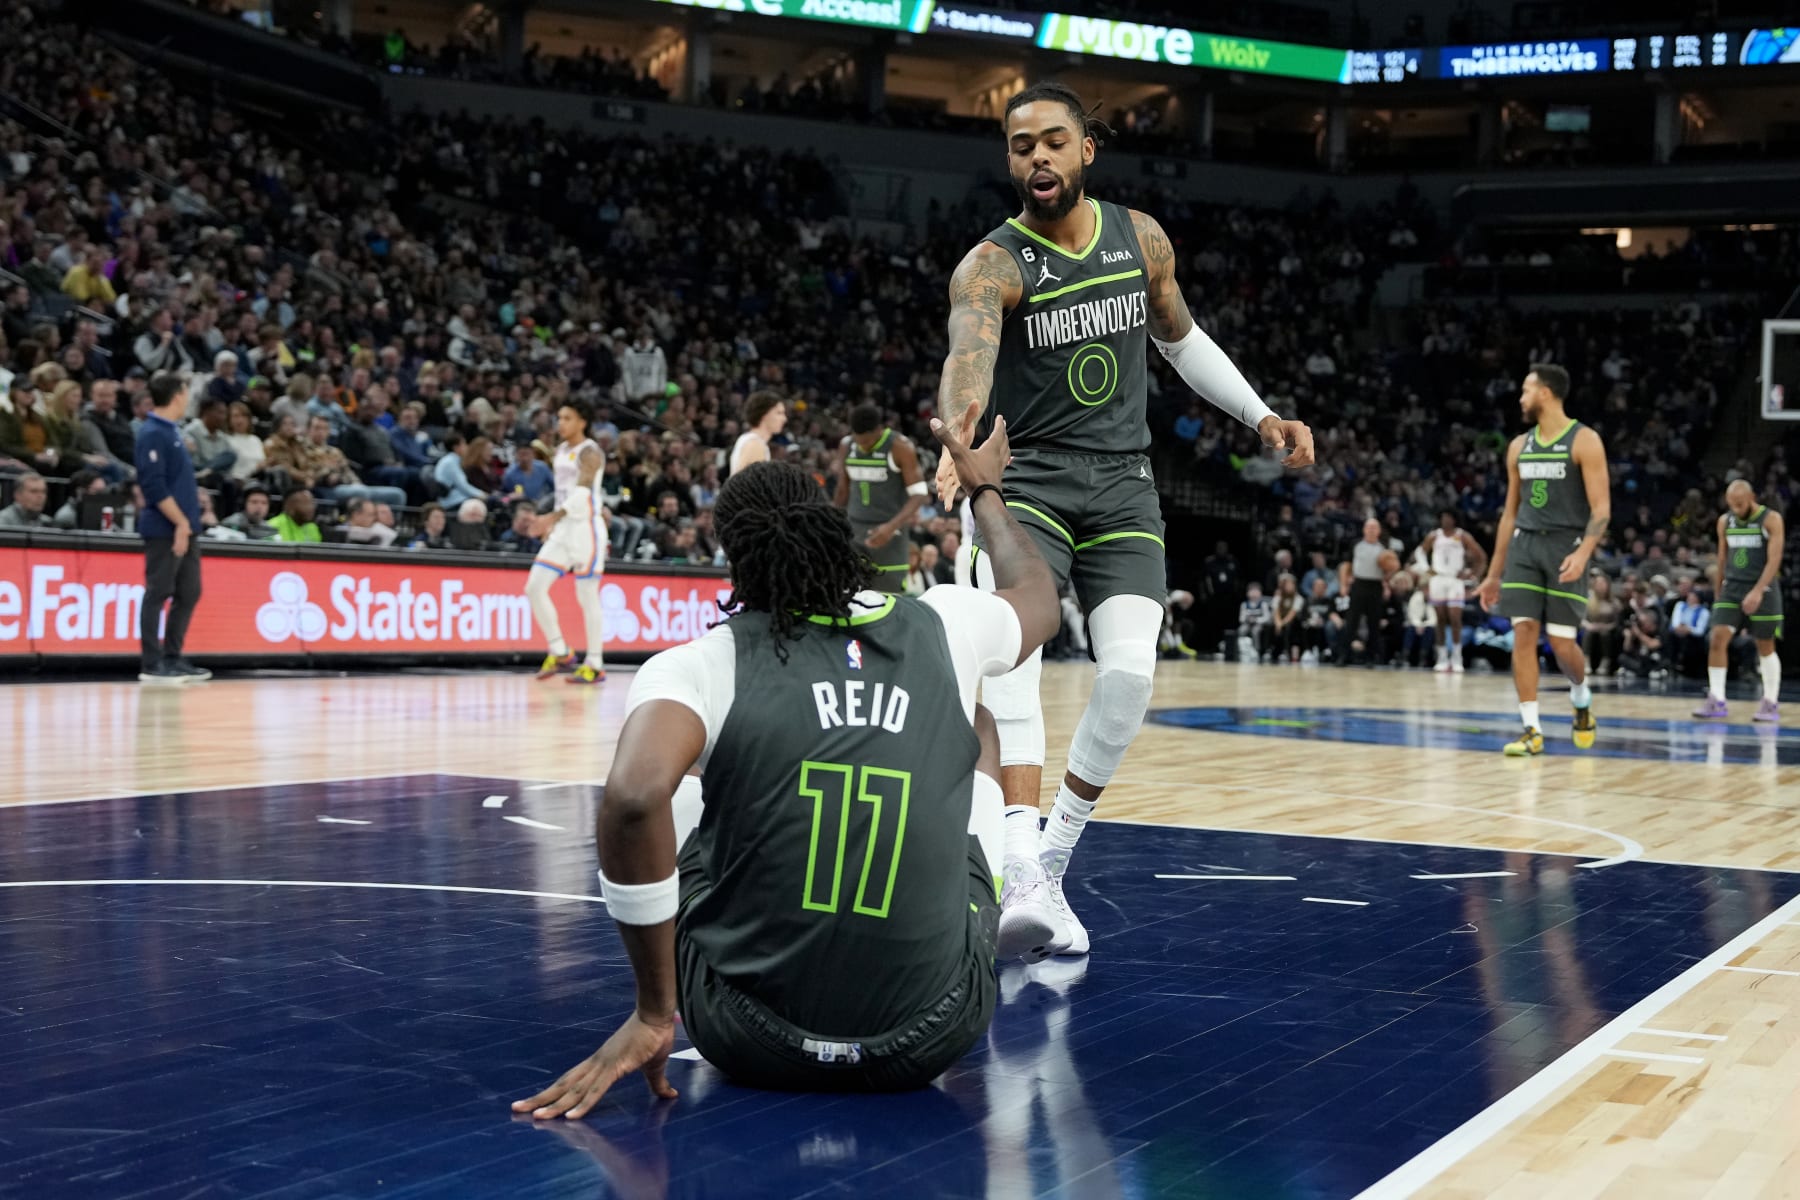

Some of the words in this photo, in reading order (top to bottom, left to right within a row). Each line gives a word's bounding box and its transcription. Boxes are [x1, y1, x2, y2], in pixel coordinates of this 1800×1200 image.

[1064, 14, 1194, 65] More
[1208, 38, 1270, 69] Wolv
[1471, 42, 1580, 58] MINNESOTA
[1450, 51, 1598, 77] TIMBERWOLVES
[1021, 246, 1036, 263] 6
[1023, 290, 1147, 351] TIMBERWOLVES
[1529, 479, 1549, 509] 5
[812, 680, 911, 735] REID
